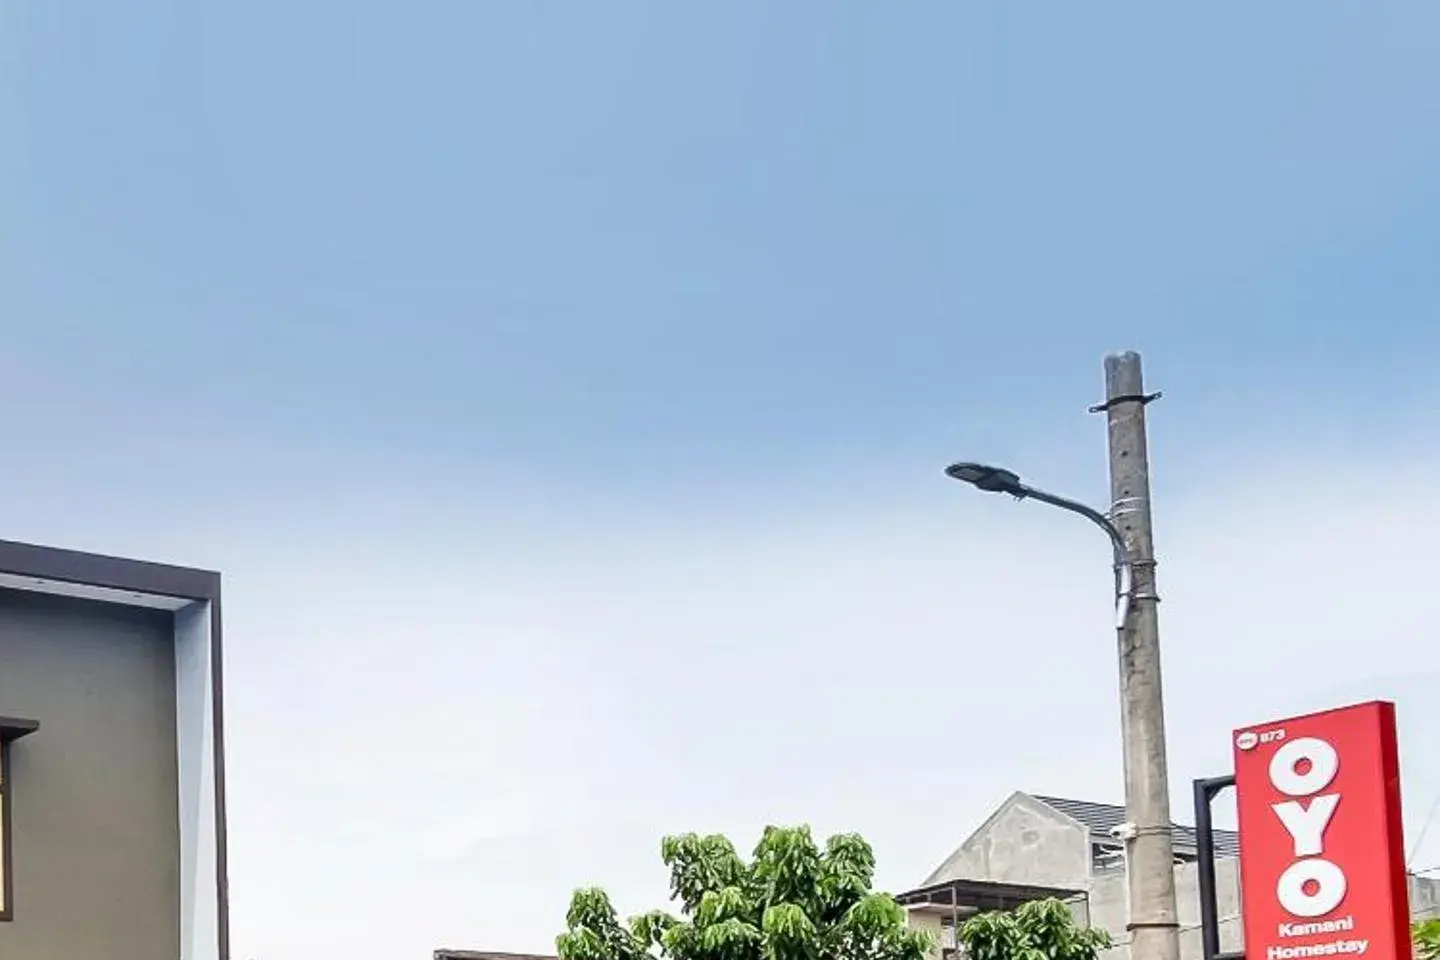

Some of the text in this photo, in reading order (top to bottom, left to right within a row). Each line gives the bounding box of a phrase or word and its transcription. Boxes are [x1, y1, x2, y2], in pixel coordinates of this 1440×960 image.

[1268, 737, 1346, 917] OYO
[1278, 915, 1354, 937] Kamani
[1268, 940, 1368, 960] Homestay
